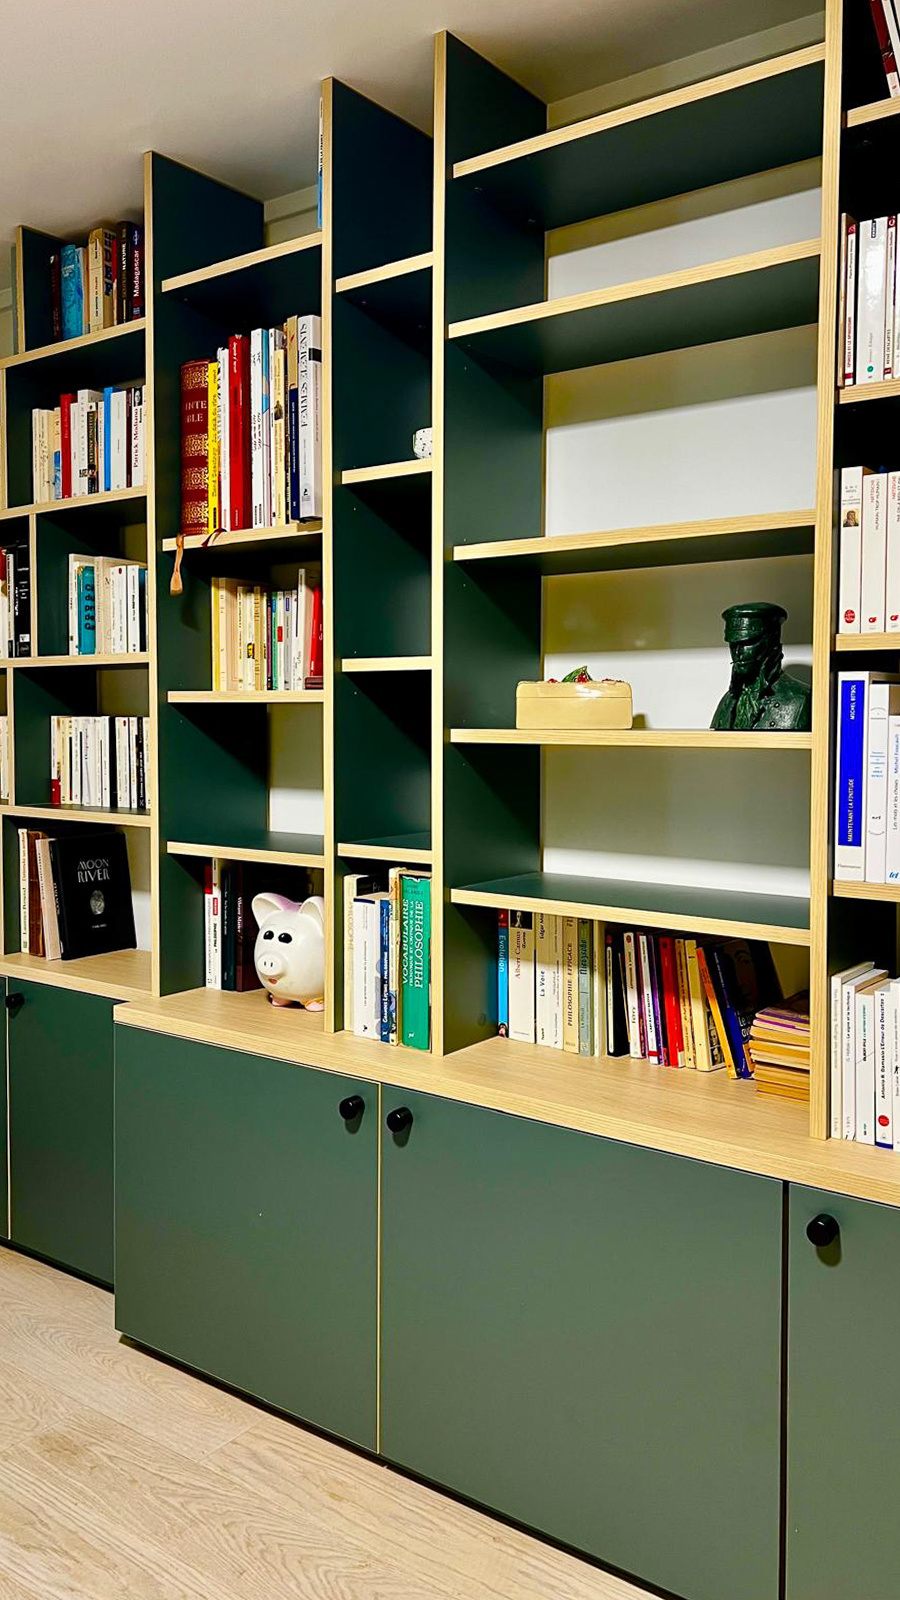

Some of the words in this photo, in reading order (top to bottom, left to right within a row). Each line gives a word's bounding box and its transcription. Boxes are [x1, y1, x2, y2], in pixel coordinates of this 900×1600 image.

[133, 250, 141, 297] Madagascar
[300, 382, 308, 428] FEMMES
[77, 858, 110, 871] MOON
[78, 868, 111, 883] RIVER
[414, 900, 424, 989] PHILOSOPHIE
[498, 935, 506, 973] Evolution
[539, 989, 545, 997] La
